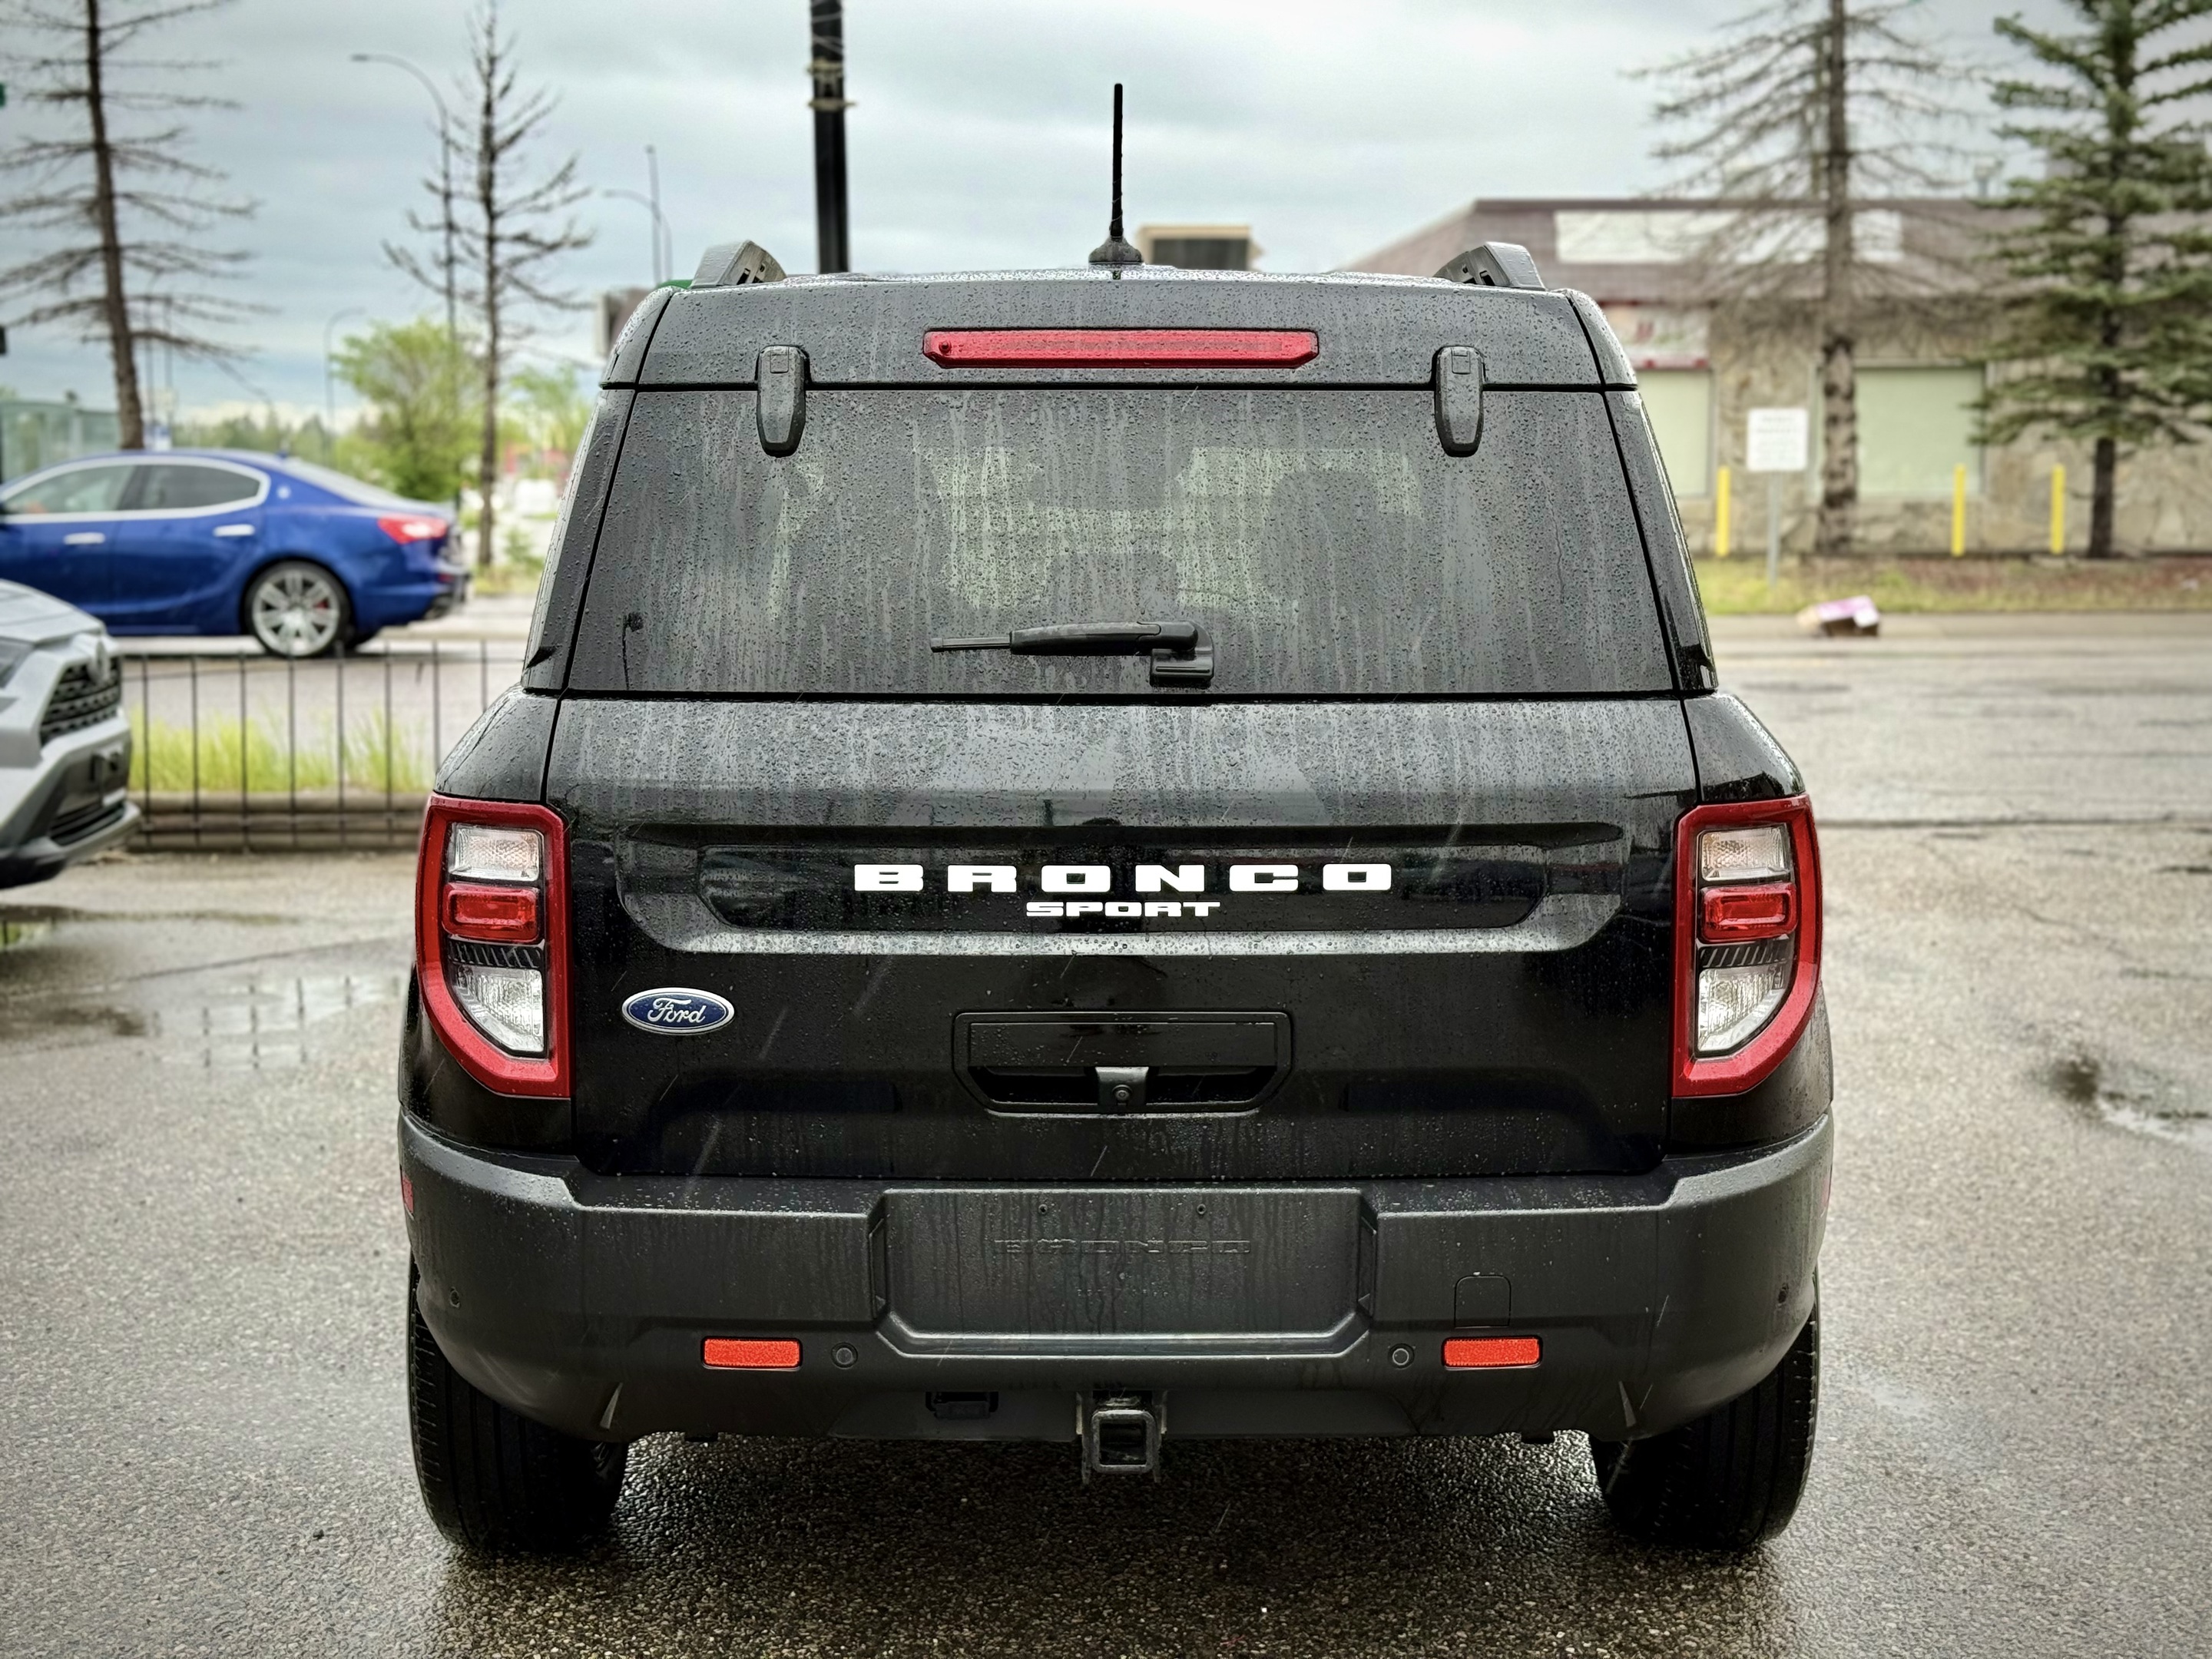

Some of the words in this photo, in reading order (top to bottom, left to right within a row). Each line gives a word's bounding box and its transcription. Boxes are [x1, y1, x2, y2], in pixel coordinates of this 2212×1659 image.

[854, 863, 1392, 892] BRONCO
[1026, 902, 1220, 917] SPORT
[647, 997, 706, 1023] Ford
